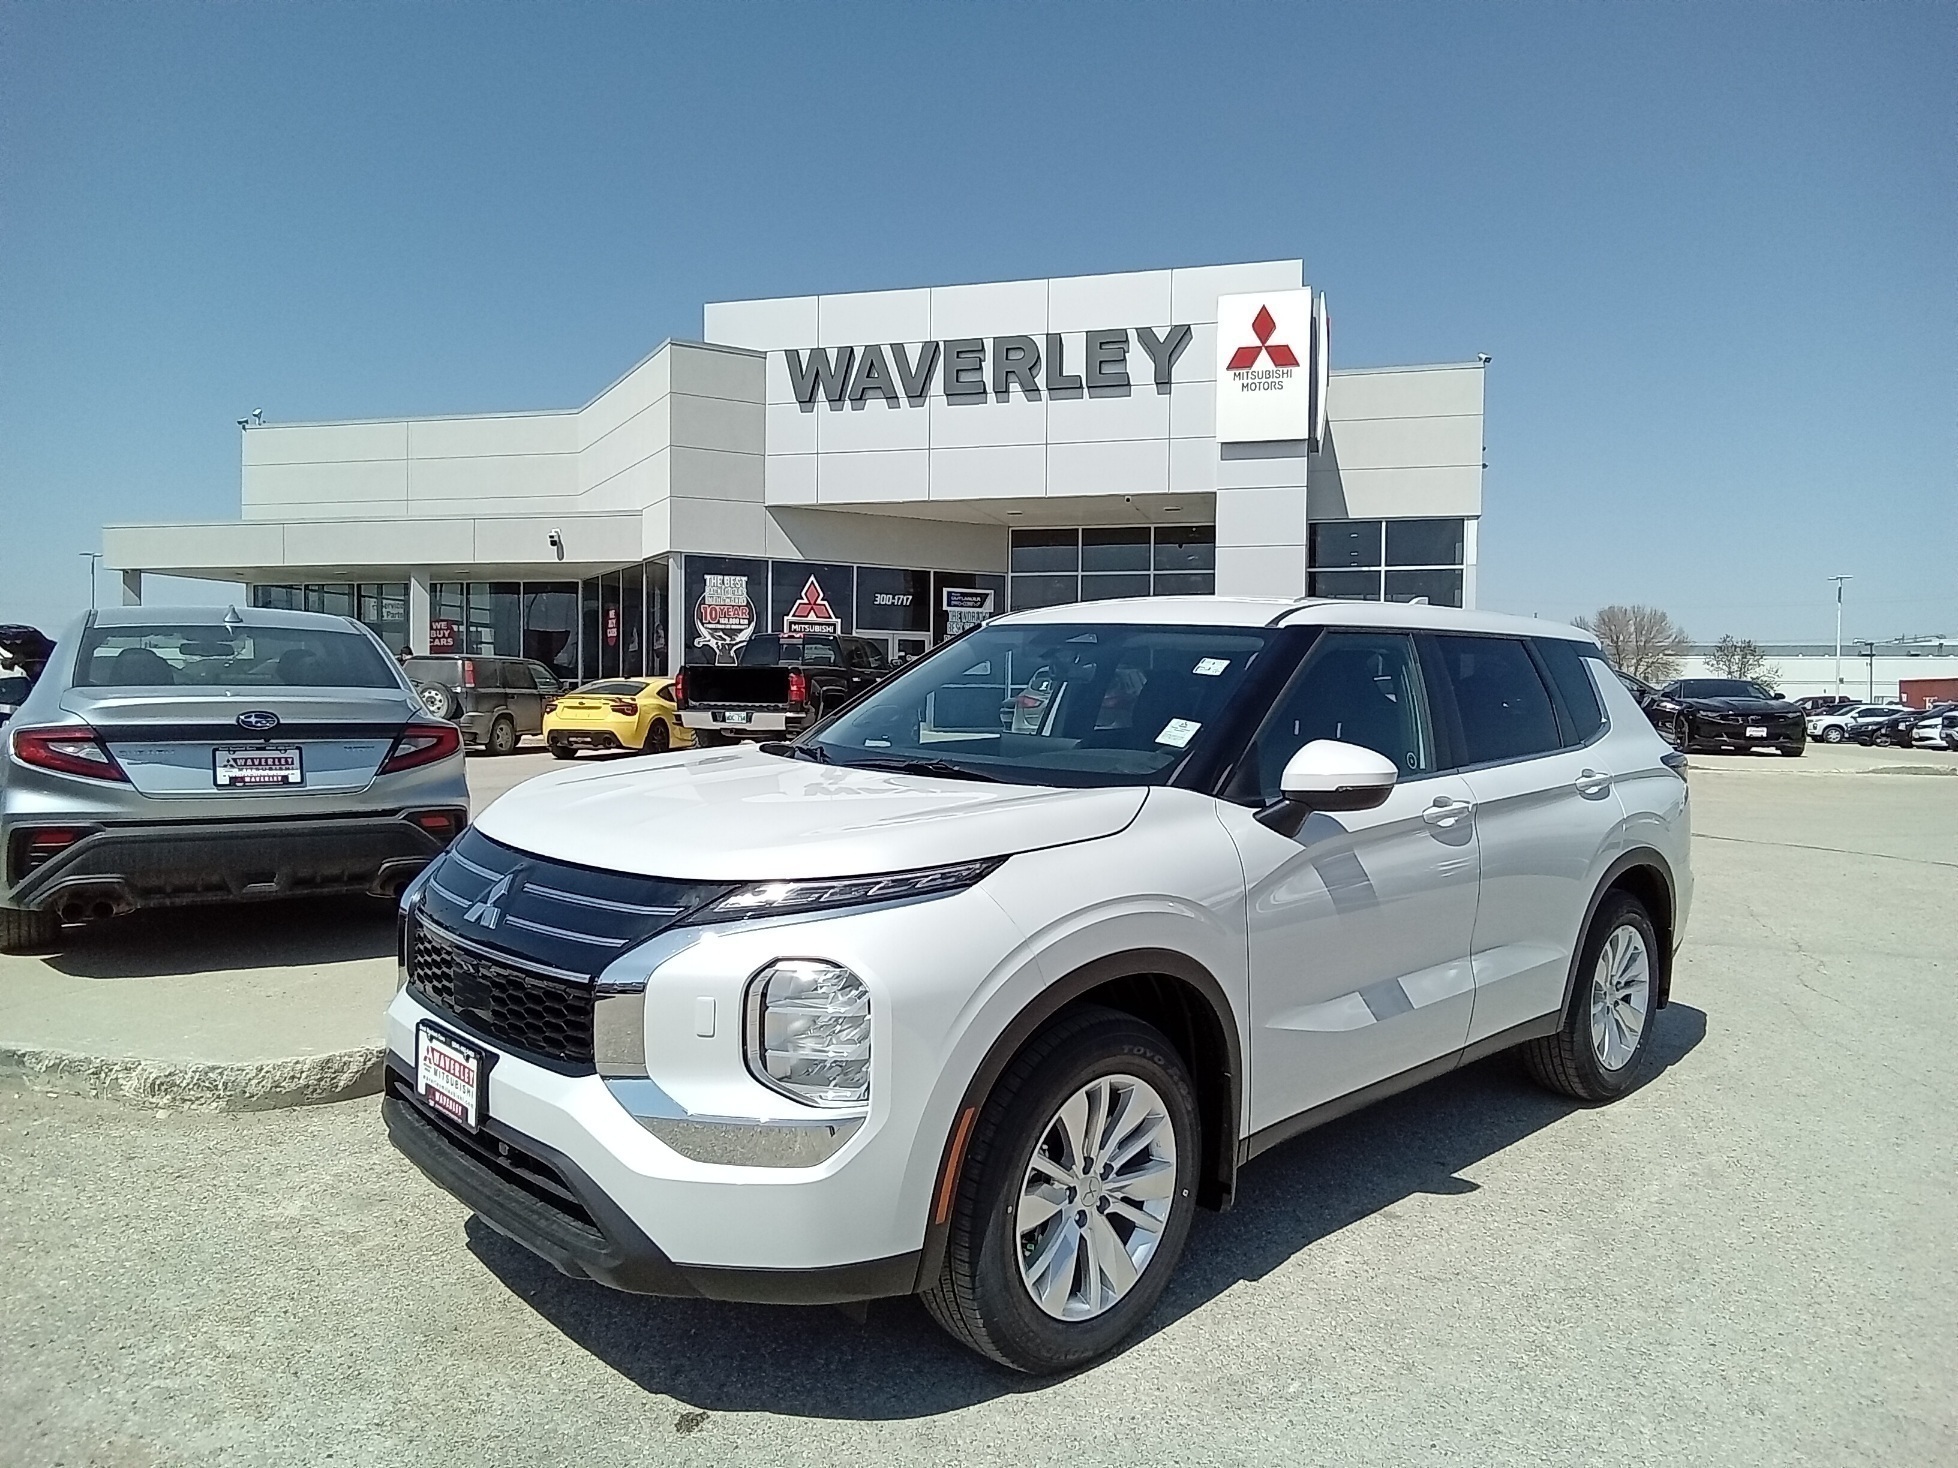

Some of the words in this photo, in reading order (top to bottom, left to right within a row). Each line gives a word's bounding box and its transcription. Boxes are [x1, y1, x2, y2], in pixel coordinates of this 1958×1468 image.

[785, 324, 1193, 413] WAVERLEY
[1233, 369, 1293, 381] MITSUBISHI
[1241, 381, 1284, 392] MOTORS
[704, 574, 723, 587] THE
[723, 575, 748, 588] BEST
[874, 593, 913, 606] 300-1717
[701, 605, 719, 623] 10
[719, 606, 749, 618] YEAR
[432, 621, 448, 629] WE
[791, 623, 834, 633] MITSUBISHI
[431, 630, 451, 638] BUY
[236, 758, 293, 766] WAVERLEY
[433, 1048, 474, 1086] WAVERLEY
[433, 1067, 474, 1100] MITSUBISHI
